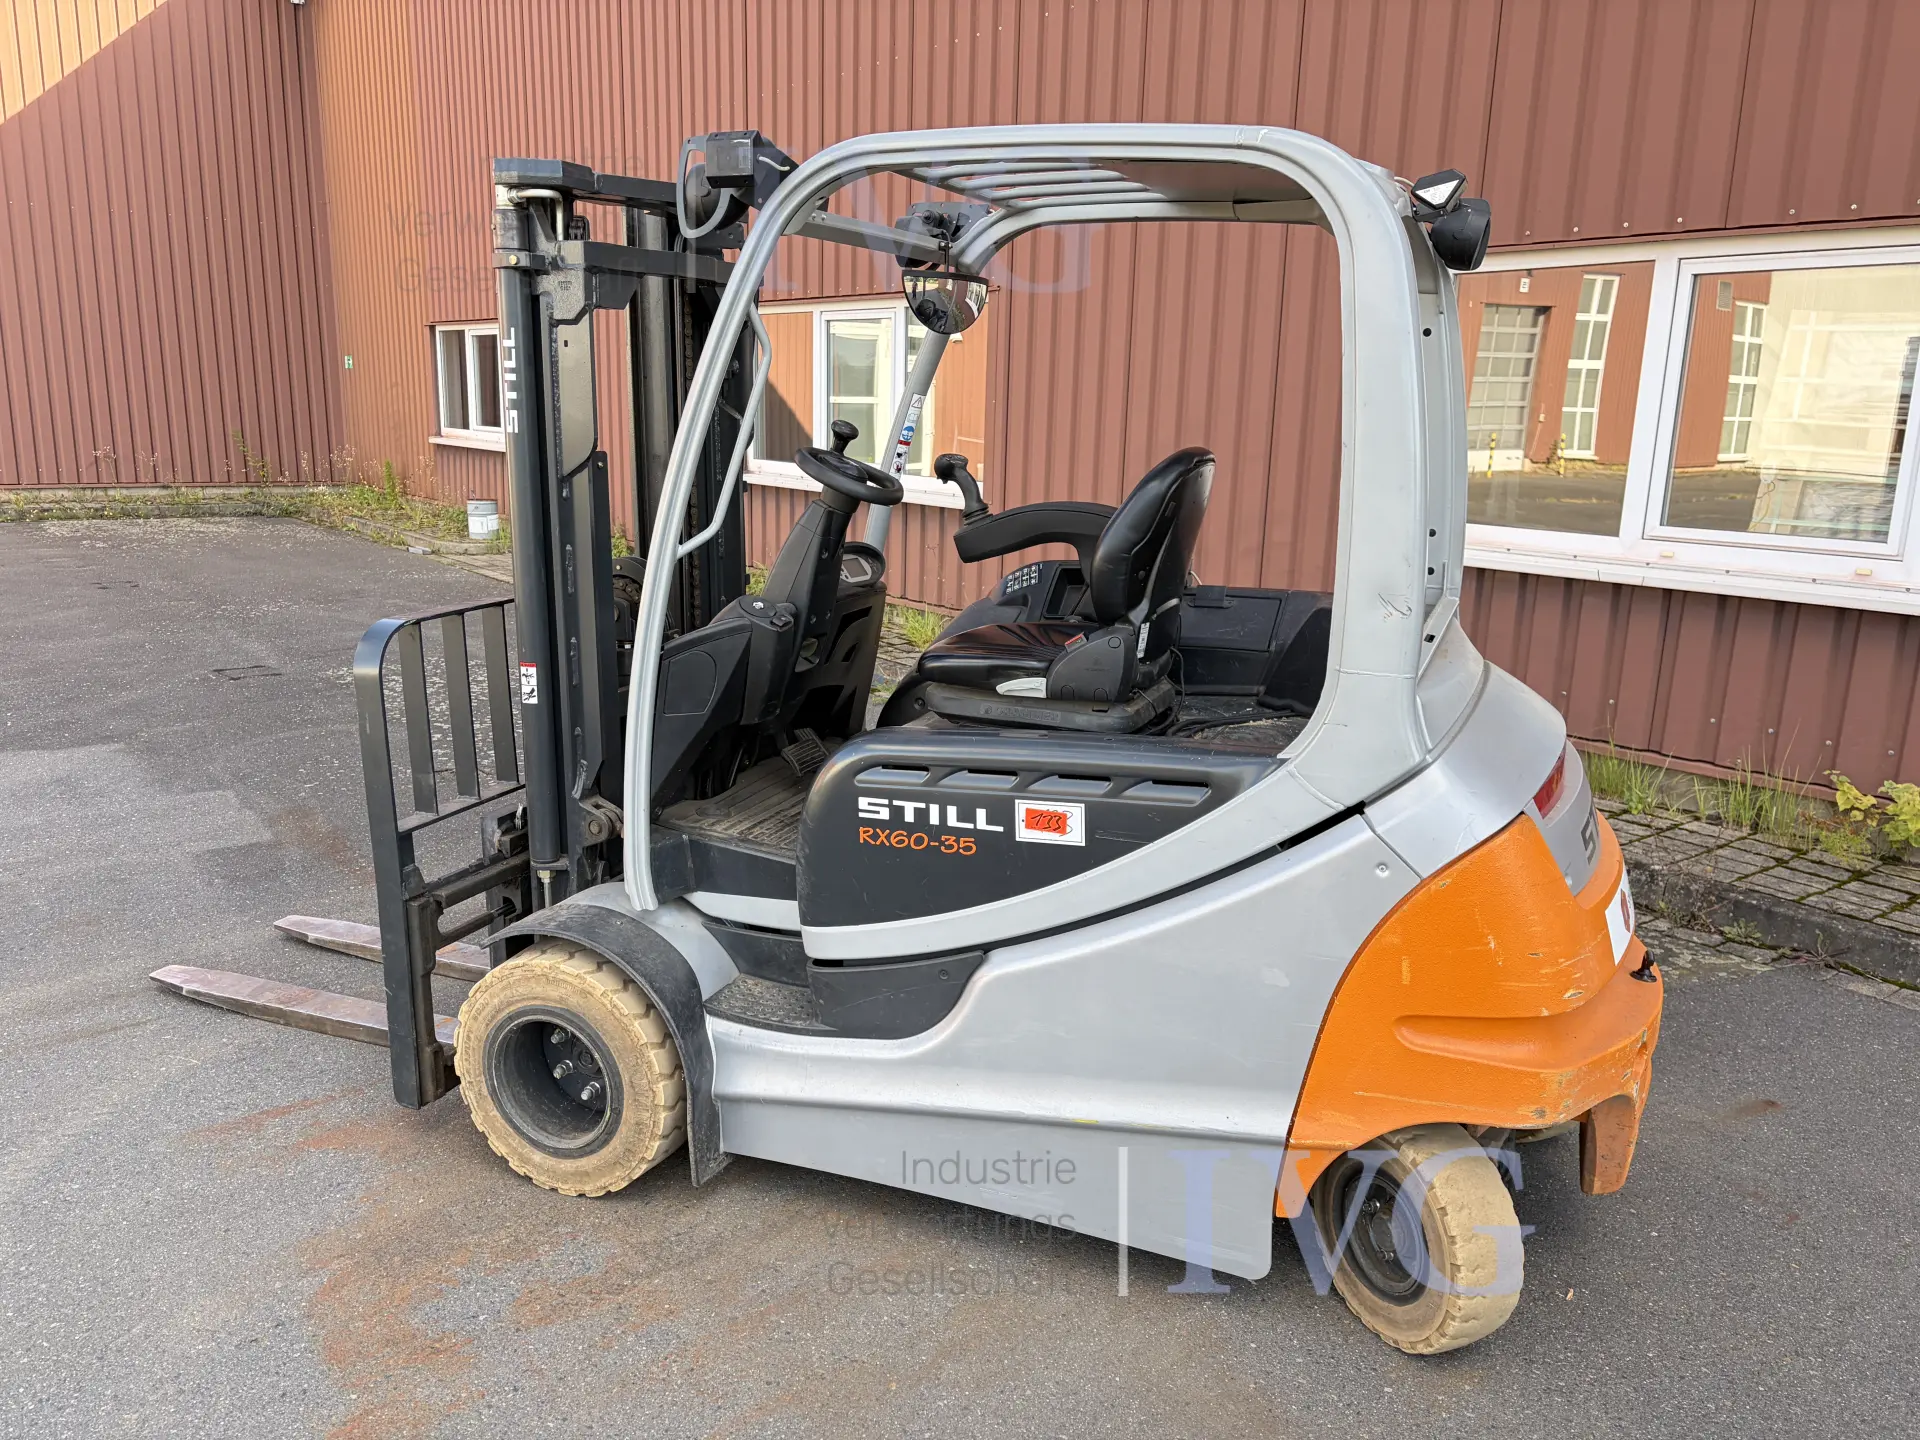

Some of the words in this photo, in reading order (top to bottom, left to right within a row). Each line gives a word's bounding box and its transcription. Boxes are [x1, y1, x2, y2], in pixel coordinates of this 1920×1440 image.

[502, 327, 519, 434] STILL
[857, 796, 1004, 833] STILL
[1030, 812, 1063, 832] 133
[858, 826, 977, 856] RX60-35
